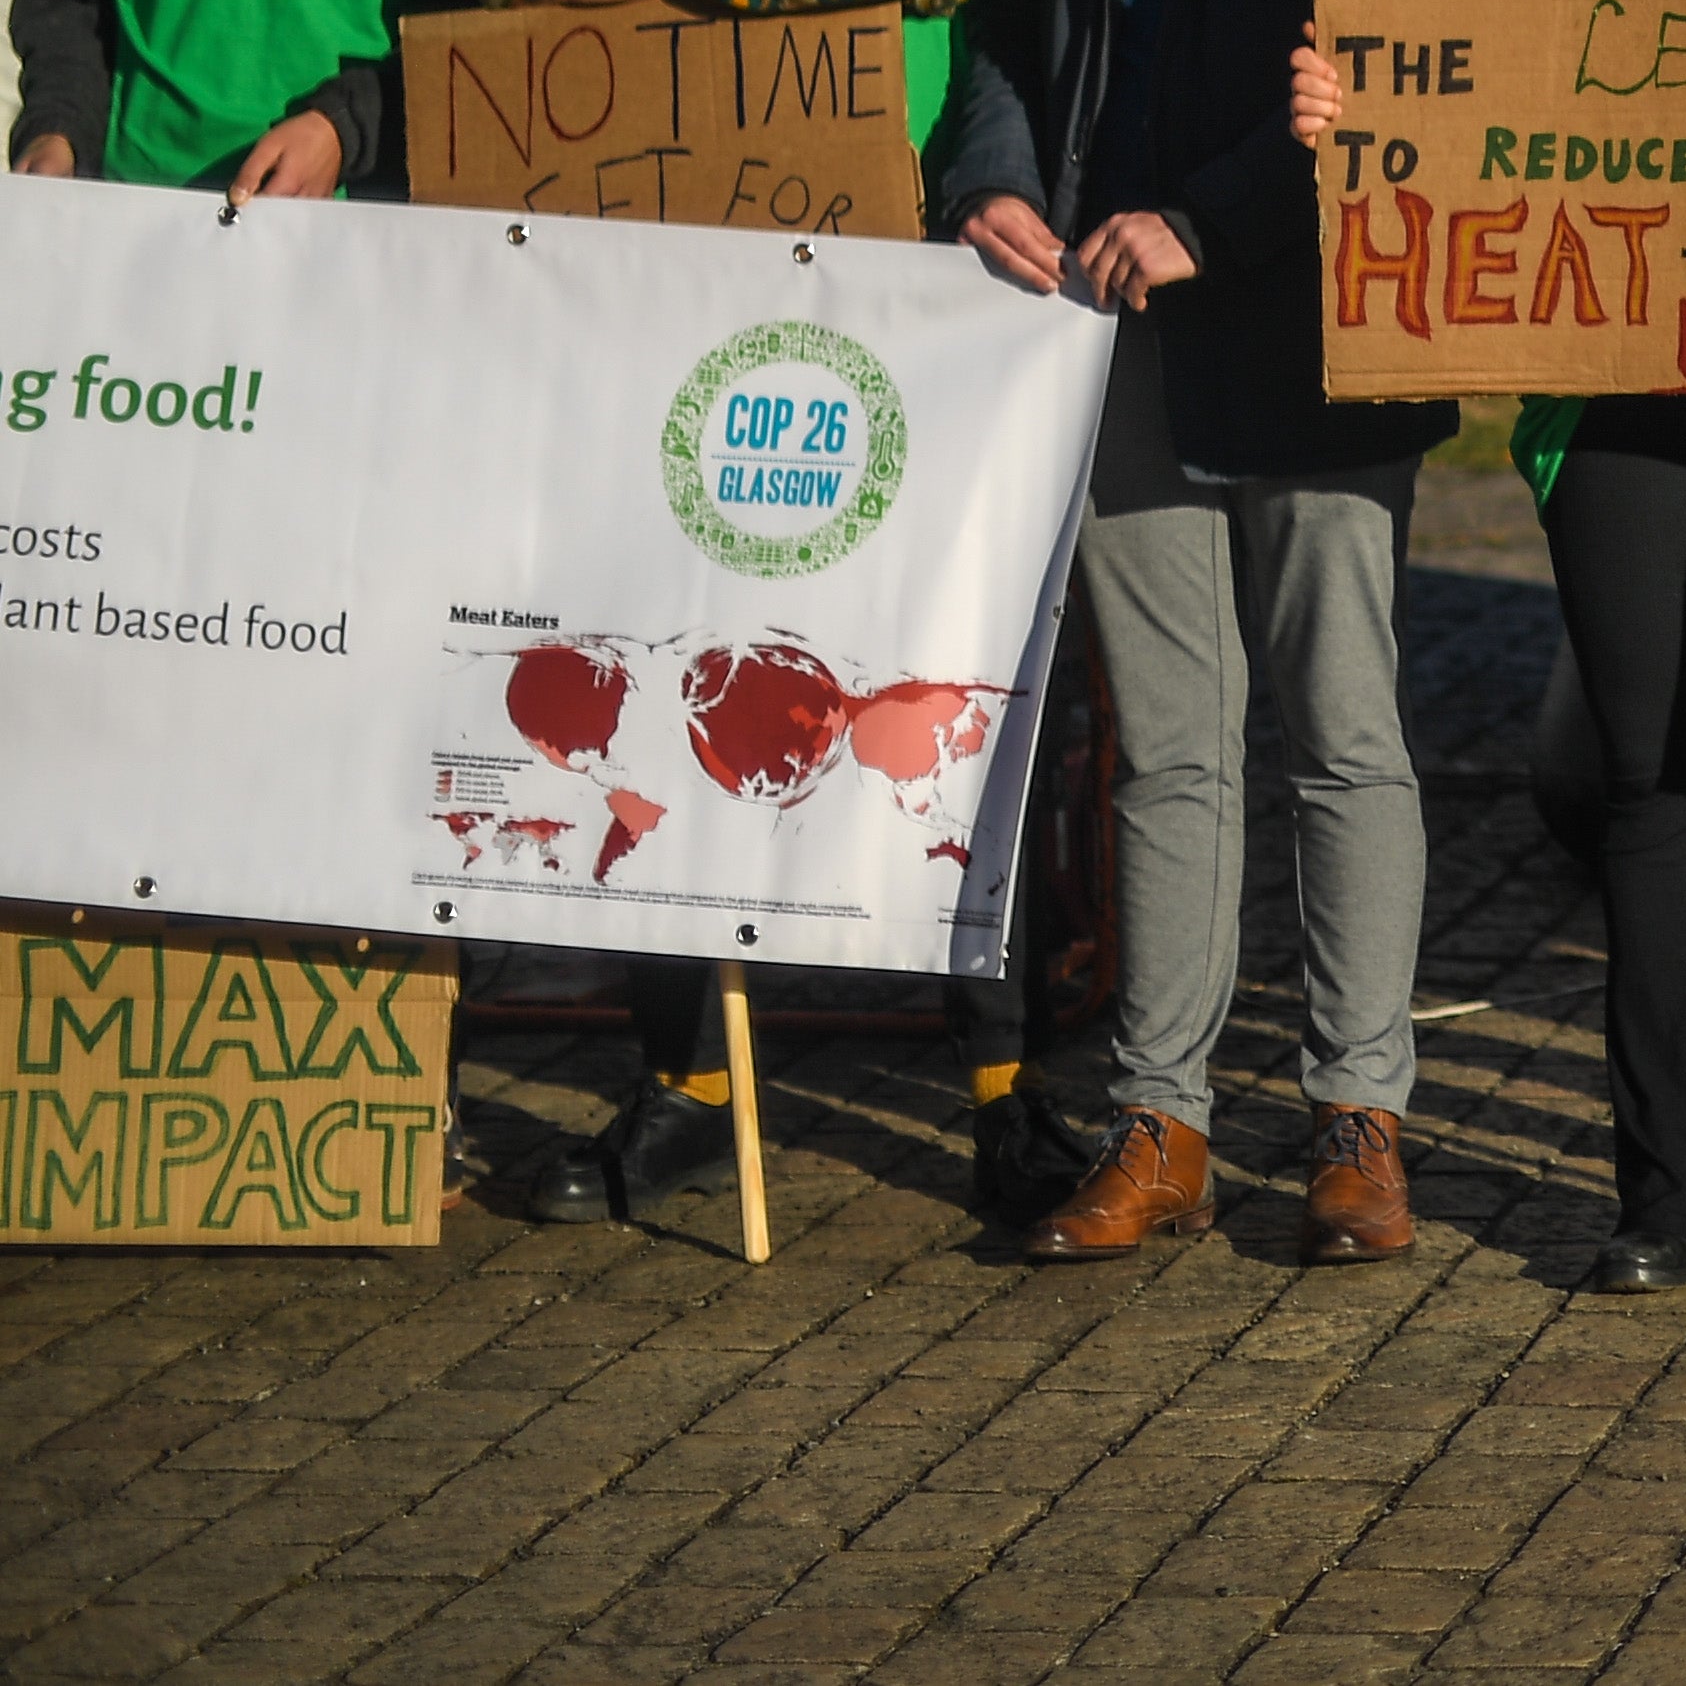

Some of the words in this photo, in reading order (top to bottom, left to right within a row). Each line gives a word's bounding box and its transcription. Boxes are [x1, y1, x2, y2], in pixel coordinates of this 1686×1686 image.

[447, 24, 615, 180] NO
[634, 17, 890, 143] TIME
[1334, 35, 1475, 96] THE
[722, 157, 853, 237] FOR
[1333, 129, 1419, 193] TO
[1334, 187, 1671, 342] HEAT
[71, 353, 263, 434] food!
[724, 393, 795, 451] COP
[800, 398, 849, 454] 26
[717, 464, 843, 509] GLASGOW
[0, 581, 82, 634] ant
[94, 590, 231, 647] based
[242, 603, 349, 656] food
[449, 605, 497, 626] Meat
[500, 608, 560, 630] Eaters
[17, 935, 426, 1082] MAX
